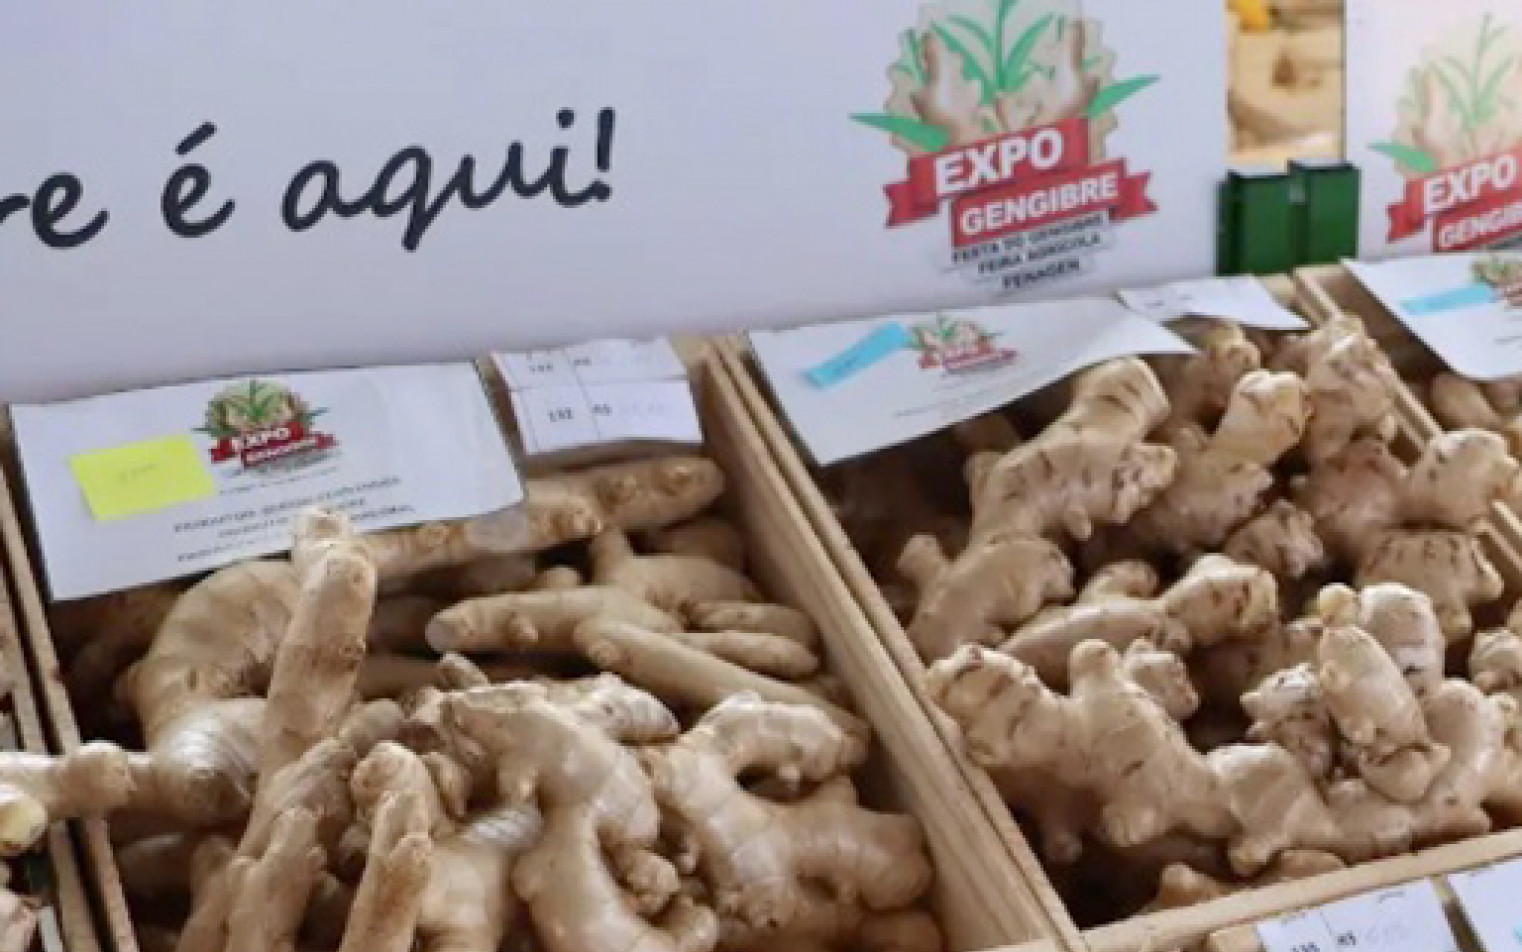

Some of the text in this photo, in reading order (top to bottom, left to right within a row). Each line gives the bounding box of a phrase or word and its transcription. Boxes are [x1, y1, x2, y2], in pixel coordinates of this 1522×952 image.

[160, 121, 236, 238] é
[281, 107, 616, 253] aqui!
[935, 126, 1064, 196] EXPO
[1424, 152, 1517, 212] EXPO
[959, 171, 1119, 236] GENGIBRE
[230, 424, 293, 451] EXPO
